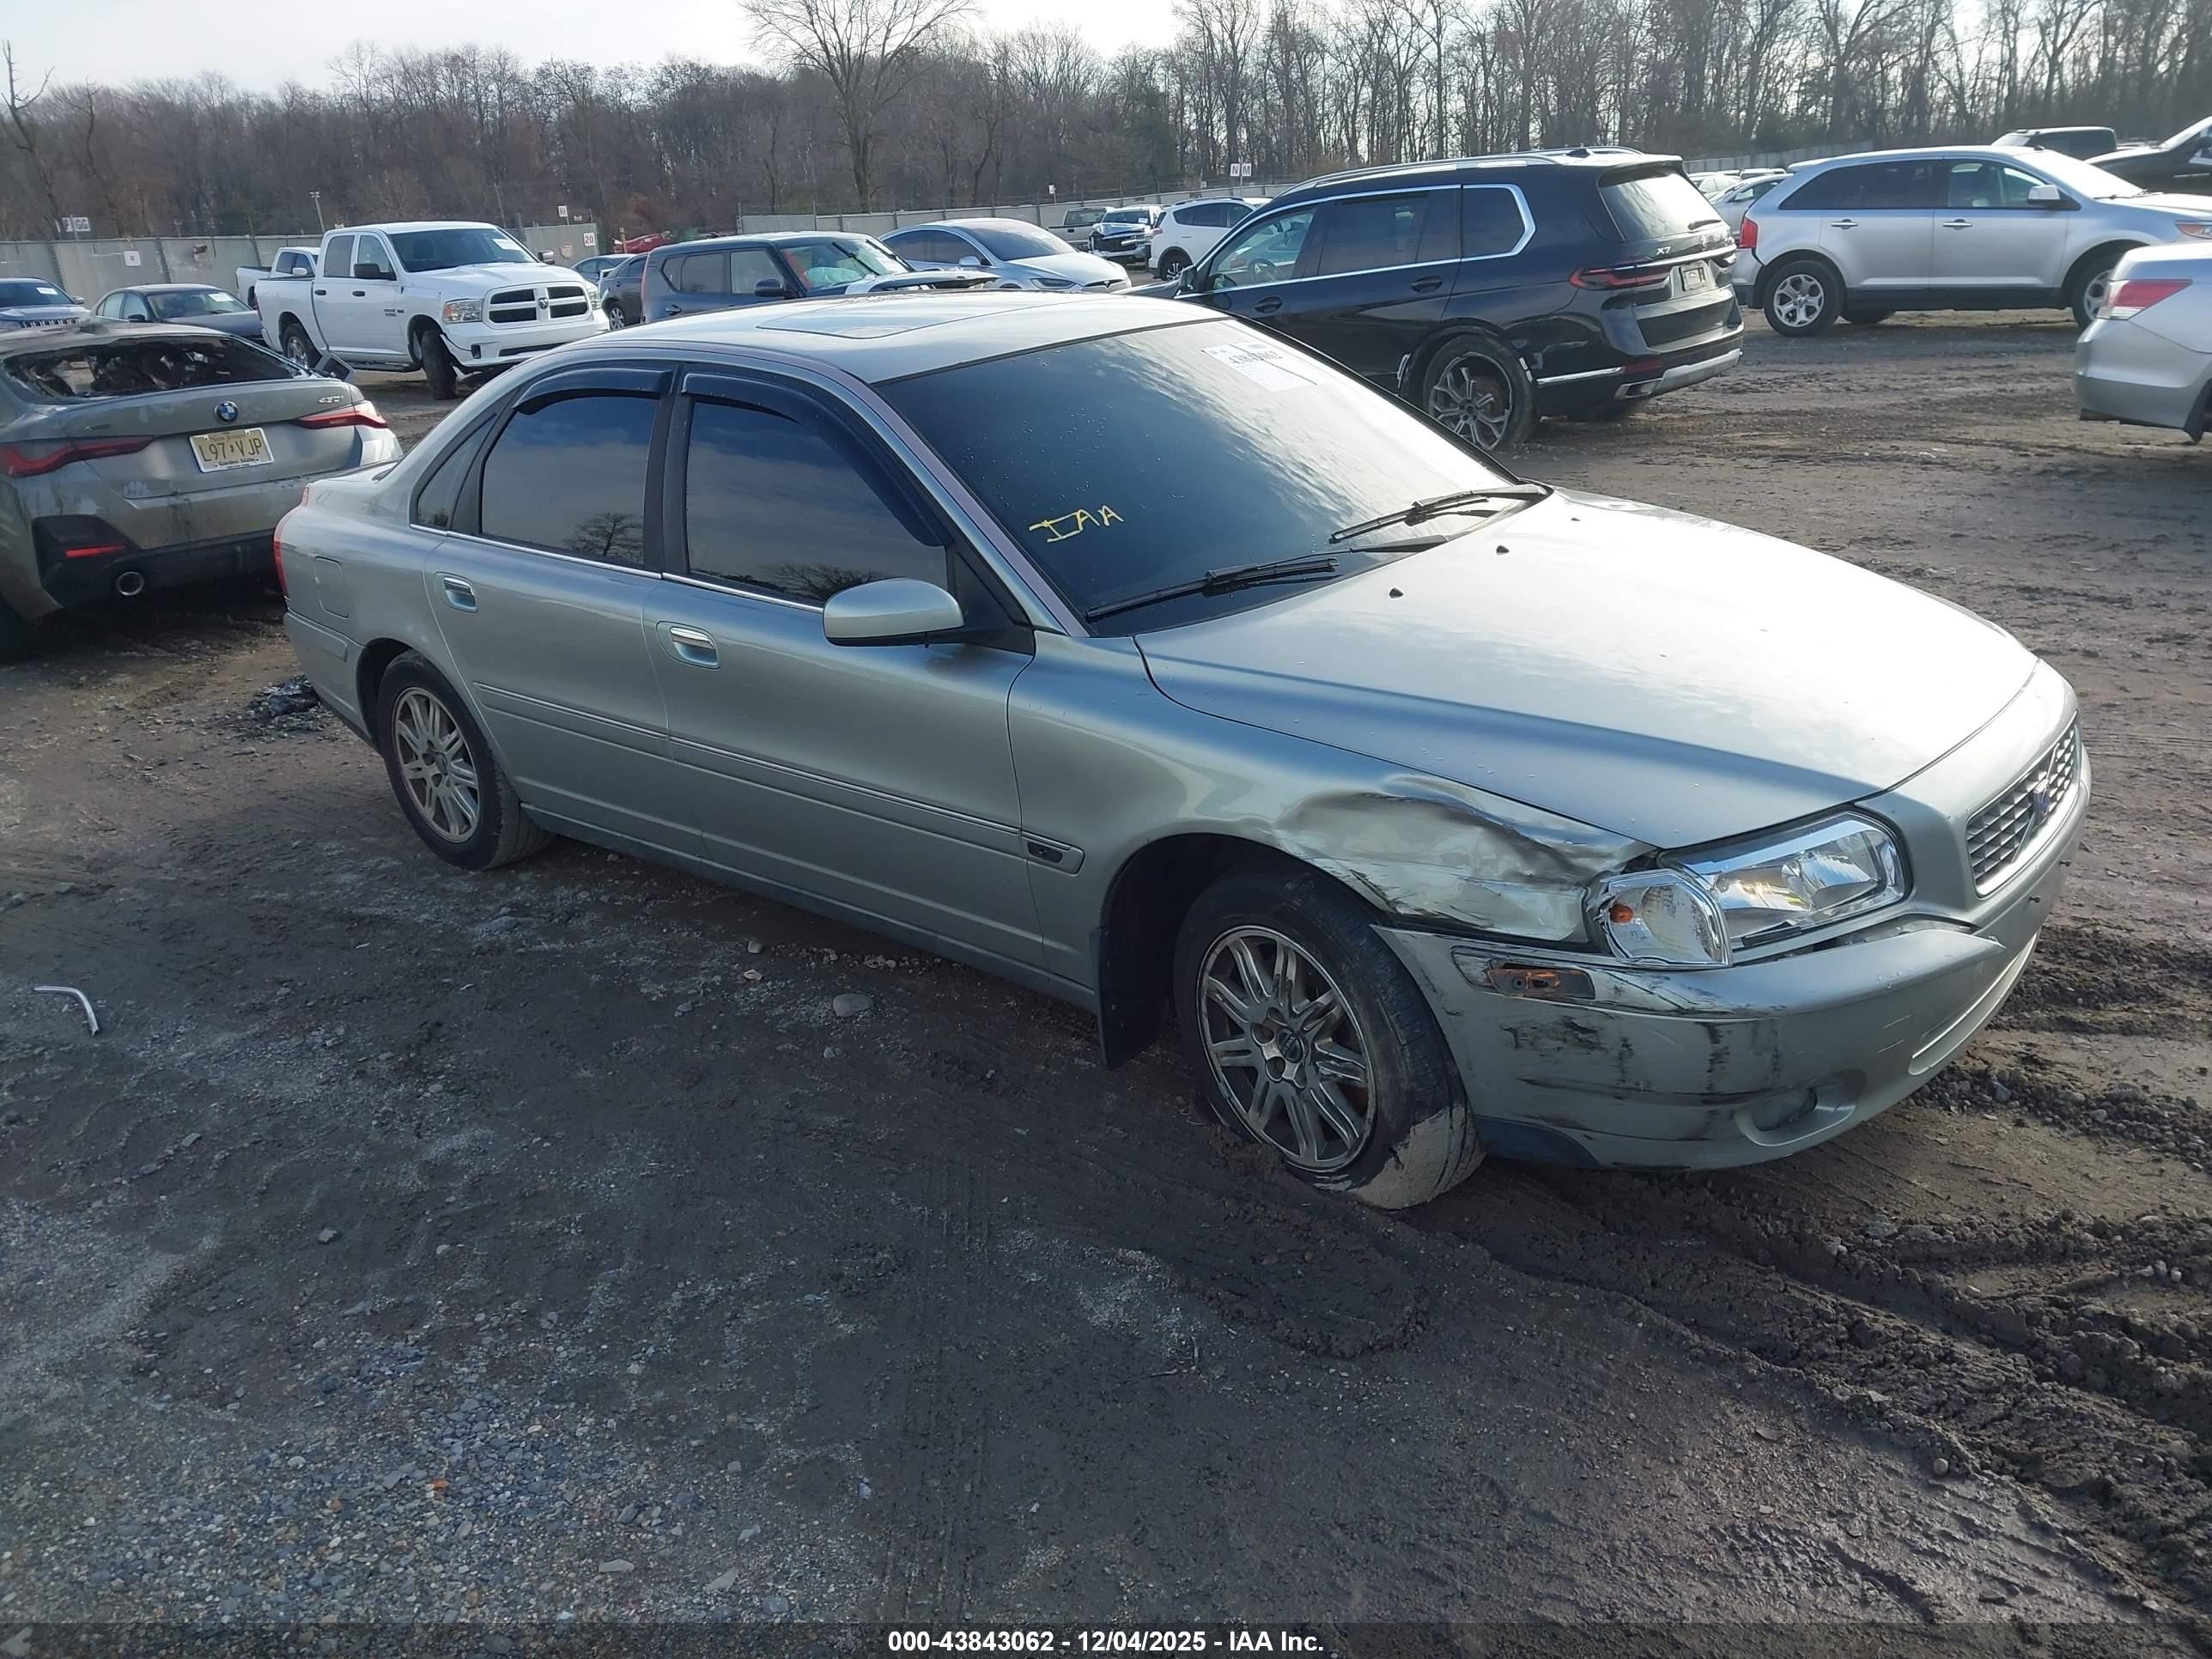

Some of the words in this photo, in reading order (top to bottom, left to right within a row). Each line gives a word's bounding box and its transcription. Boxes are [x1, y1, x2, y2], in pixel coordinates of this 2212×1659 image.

[1231, 166, 1239, 175] N
[1243, 165, 1252, 175] M
[584, 235, 594, 244] 20
[1656, 246, 1671, 255] X7
[1030, 505, 1124, 543] IAA
